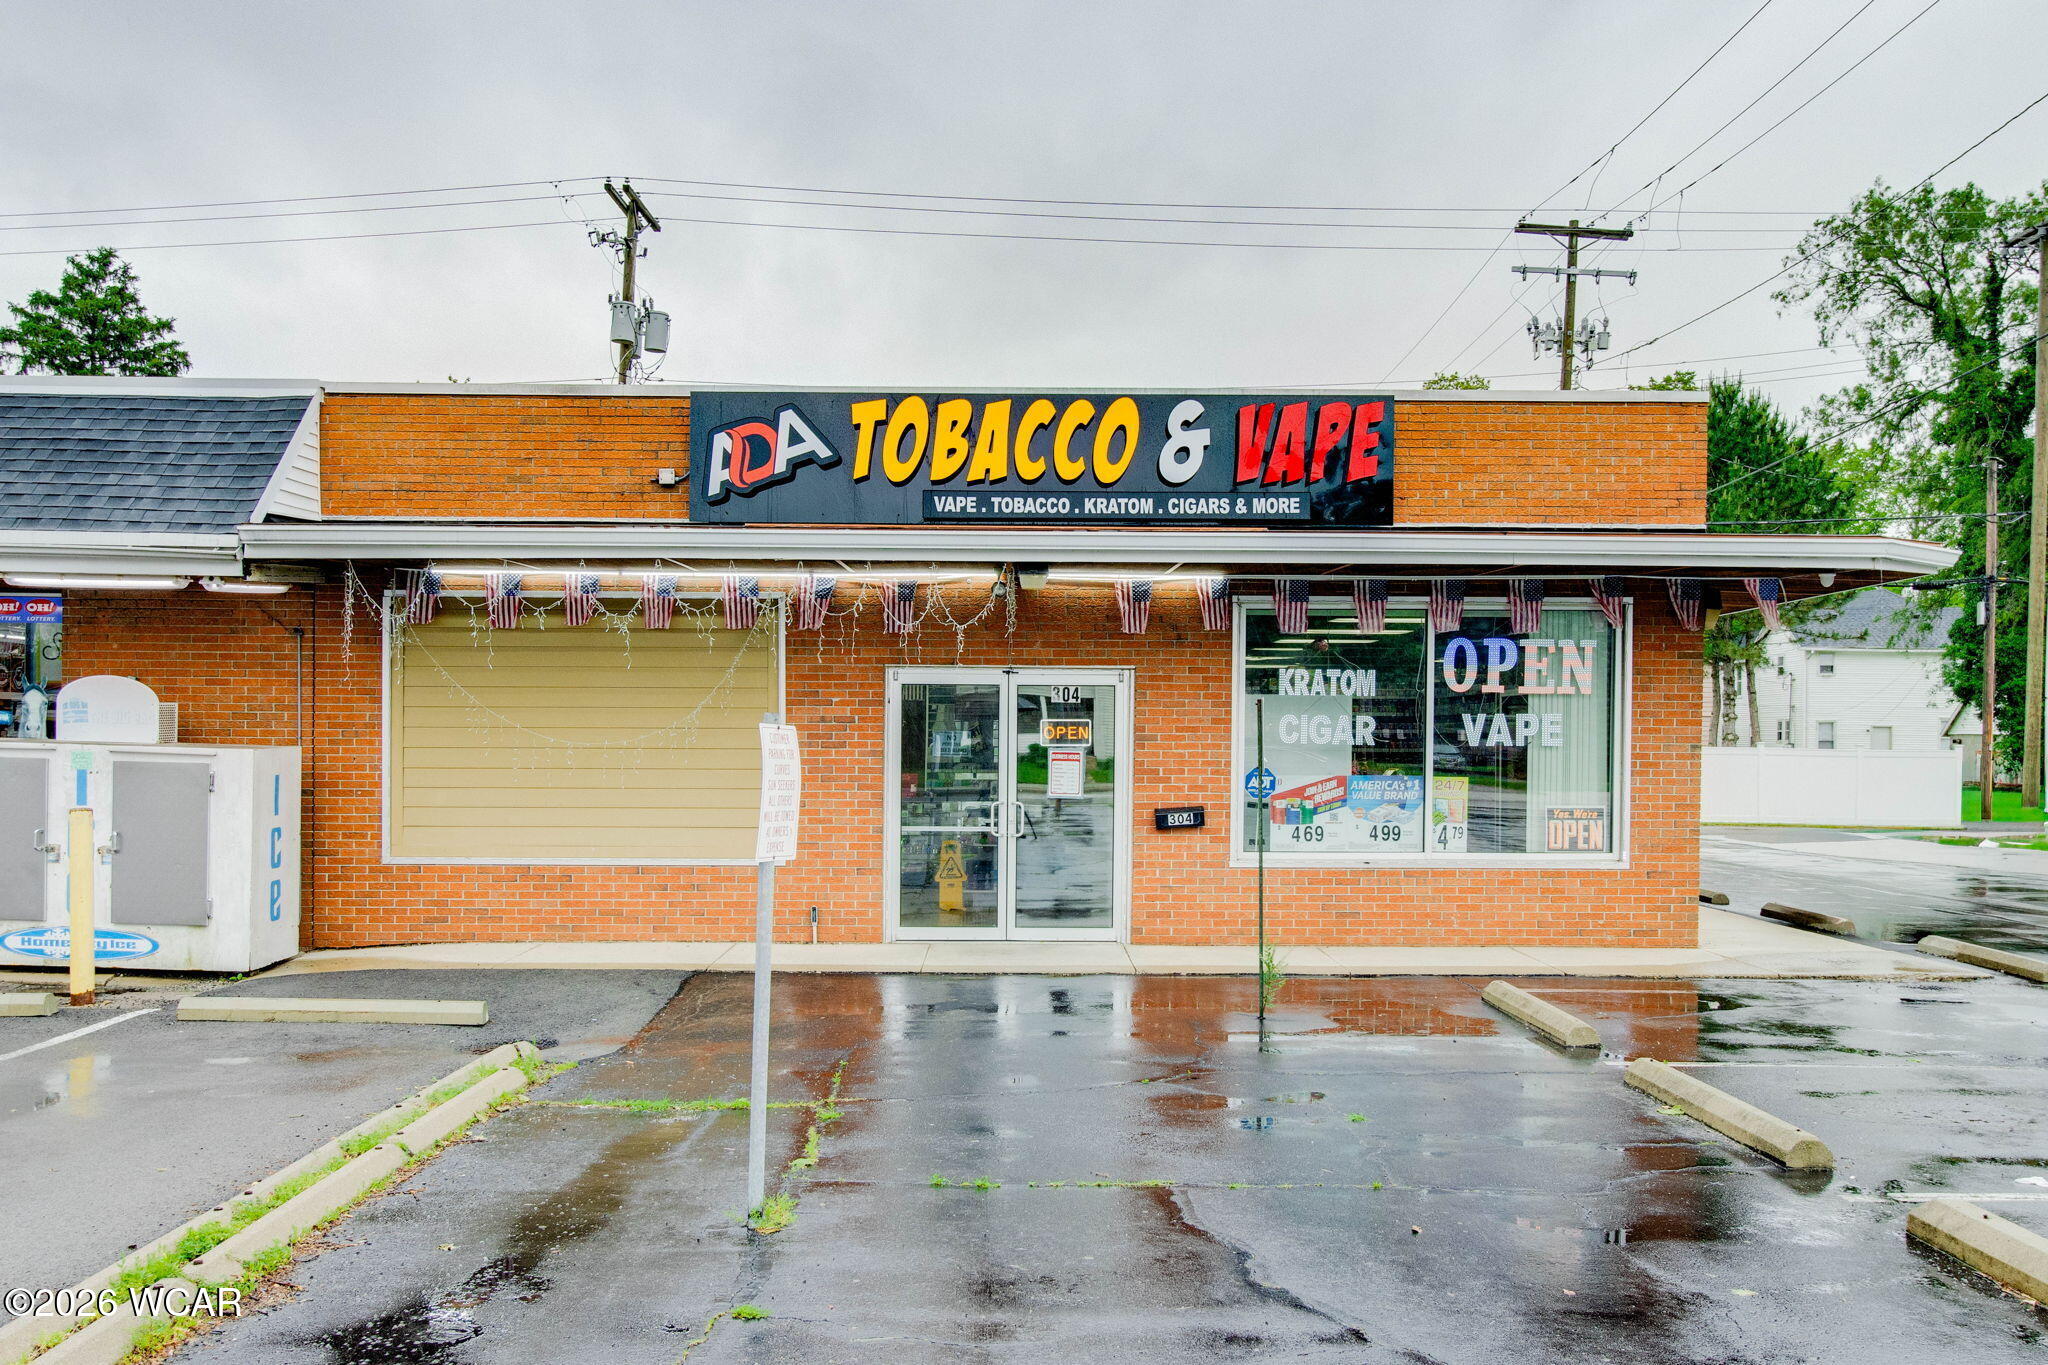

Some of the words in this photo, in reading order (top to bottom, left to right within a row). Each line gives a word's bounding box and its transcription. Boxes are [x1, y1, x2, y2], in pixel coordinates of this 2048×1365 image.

[707, 408, 834, 498] ADA
[851, 395, 1140, 484] TOBACCO
[1157, 399, 1211, 484] &
[1234, 401, 1386, 485] VAPE
[933, 496, 977, 514] VAPE
[991, 496, 1070, 515] TOBACCO
[1084, 497, 1154, 515] KRATOM
[1167, 497, 1230, 515] CIGARS
[1234, 498, 1248, 515] &
[1252, 498, 1301, 515] MORE
[0, 602, 19, 611] H!
[26, 602, 55, 612] OH!
[1443, 637, 1598, 695] OPEN
[1278, 668, 1377, 697] KRATOM
[1043, 726, 1089, 740] OPEN
[1278, 714, 1377, 747] CIGAR
[1461, 713, 1564, 748] VAPE
[1352, 791, 1381, 800] VALUE
[1384, 791, 1418, 800] BRAND
[1435, 780, 1465, 791] 24/7
[1169, 813, 1192, 825] 304
[1548, 820, 1604, 850] OPEN
